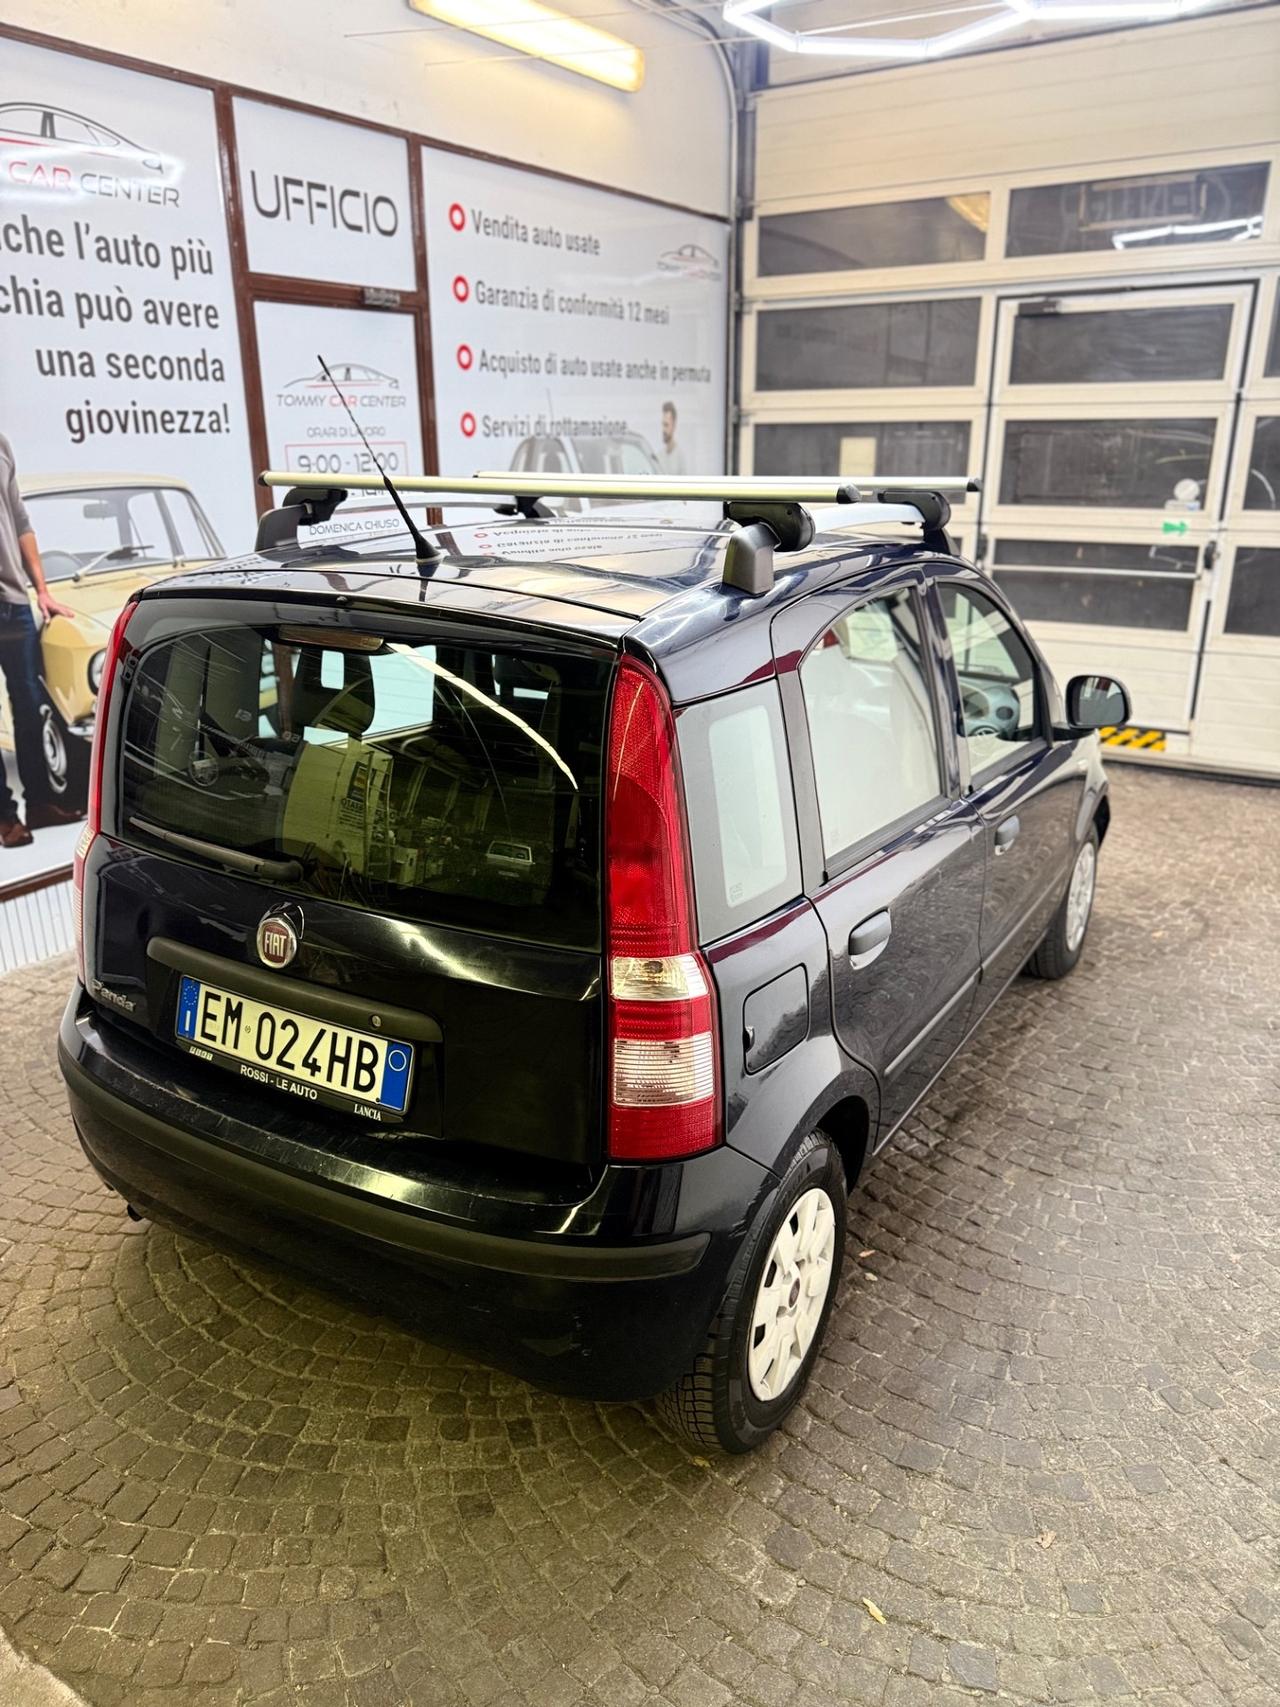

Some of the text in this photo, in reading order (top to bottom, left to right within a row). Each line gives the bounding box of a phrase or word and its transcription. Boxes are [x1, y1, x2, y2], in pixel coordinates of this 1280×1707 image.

[9, 161, 180, 208] CAR CENTER
[251, 170, 399, 238] UFFICIO
[0, 214, 65, 258] che
[170, 239, 214, 280] più
[471, 208, 600, 256] Vendita auto usate
[75, 285, 133, 329] può
[143, 299, 220, 329] avere
[475, 279, 539, 311] Garanzia
[542, 287, 555, 311] di
[627, 301, 641, 322] 12
[643, 305, 670, 325] mesi
[35, 348, 226, 383] una seconda
[479, 348, 541, 379] Acquisto
[544, 352, 558, 375] di
[561, 356, 589, 377] auto
[591, 358, 623, 378] usate
[276, 394, 407, 408] TOMMY CAR CENTER
[65, 400, 231, 444] giovinezza!
[306, 427, 338, 438] ORARI
[482, 414, 628, 438] Servizi di rottamazione
[309, 521, 363, 536] DOMENICA
[364, 518, 400, 531] CHIUSO
[264, 931, 287, 957] FIAT
[91, 979, 136, 1012] Panda
[200, 990, 379, 1093] EM 024HB
[240, 1064, 269, 1083] ROSSI
[276, 1079, 288, 1090] LE
[290, 1084, 317, 1100] AUTO
[354, 1104, 382, 1121] LANCIA
